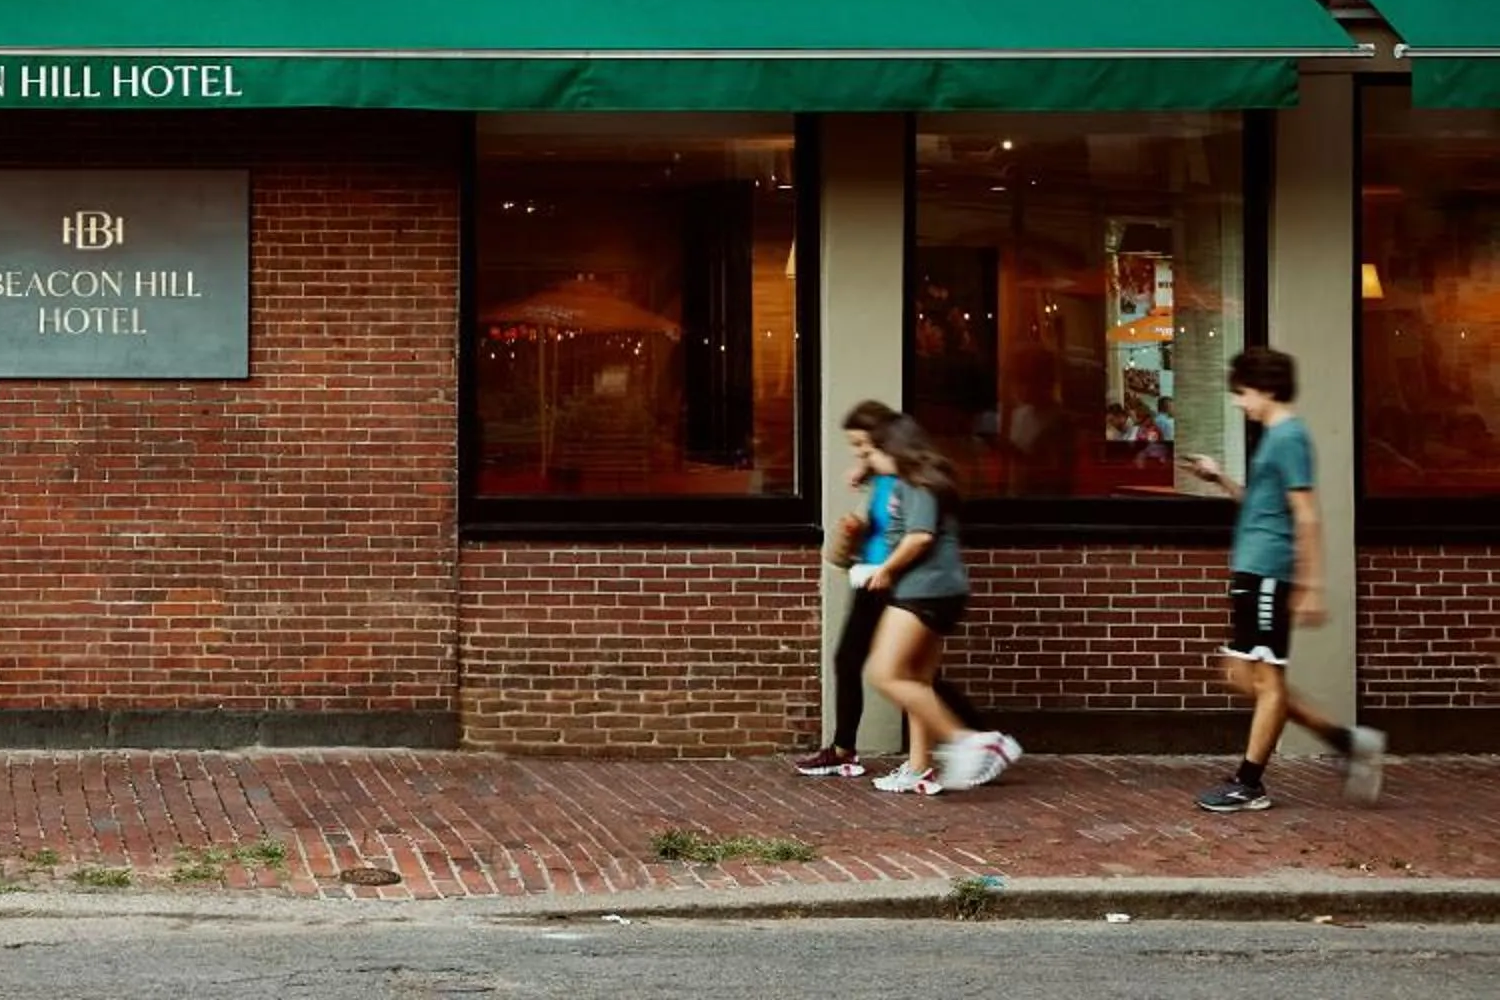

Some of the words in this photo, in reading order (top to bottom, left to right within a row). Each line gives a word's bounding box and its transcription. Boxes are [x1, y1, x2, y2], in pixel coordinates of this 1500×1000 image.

[21, 65, 101, 97] HILL
[113, 65, 242, 97] HOTEL
[135, 271, 202, 297] HILL
[38, 306, 148, 334] HOTEL
